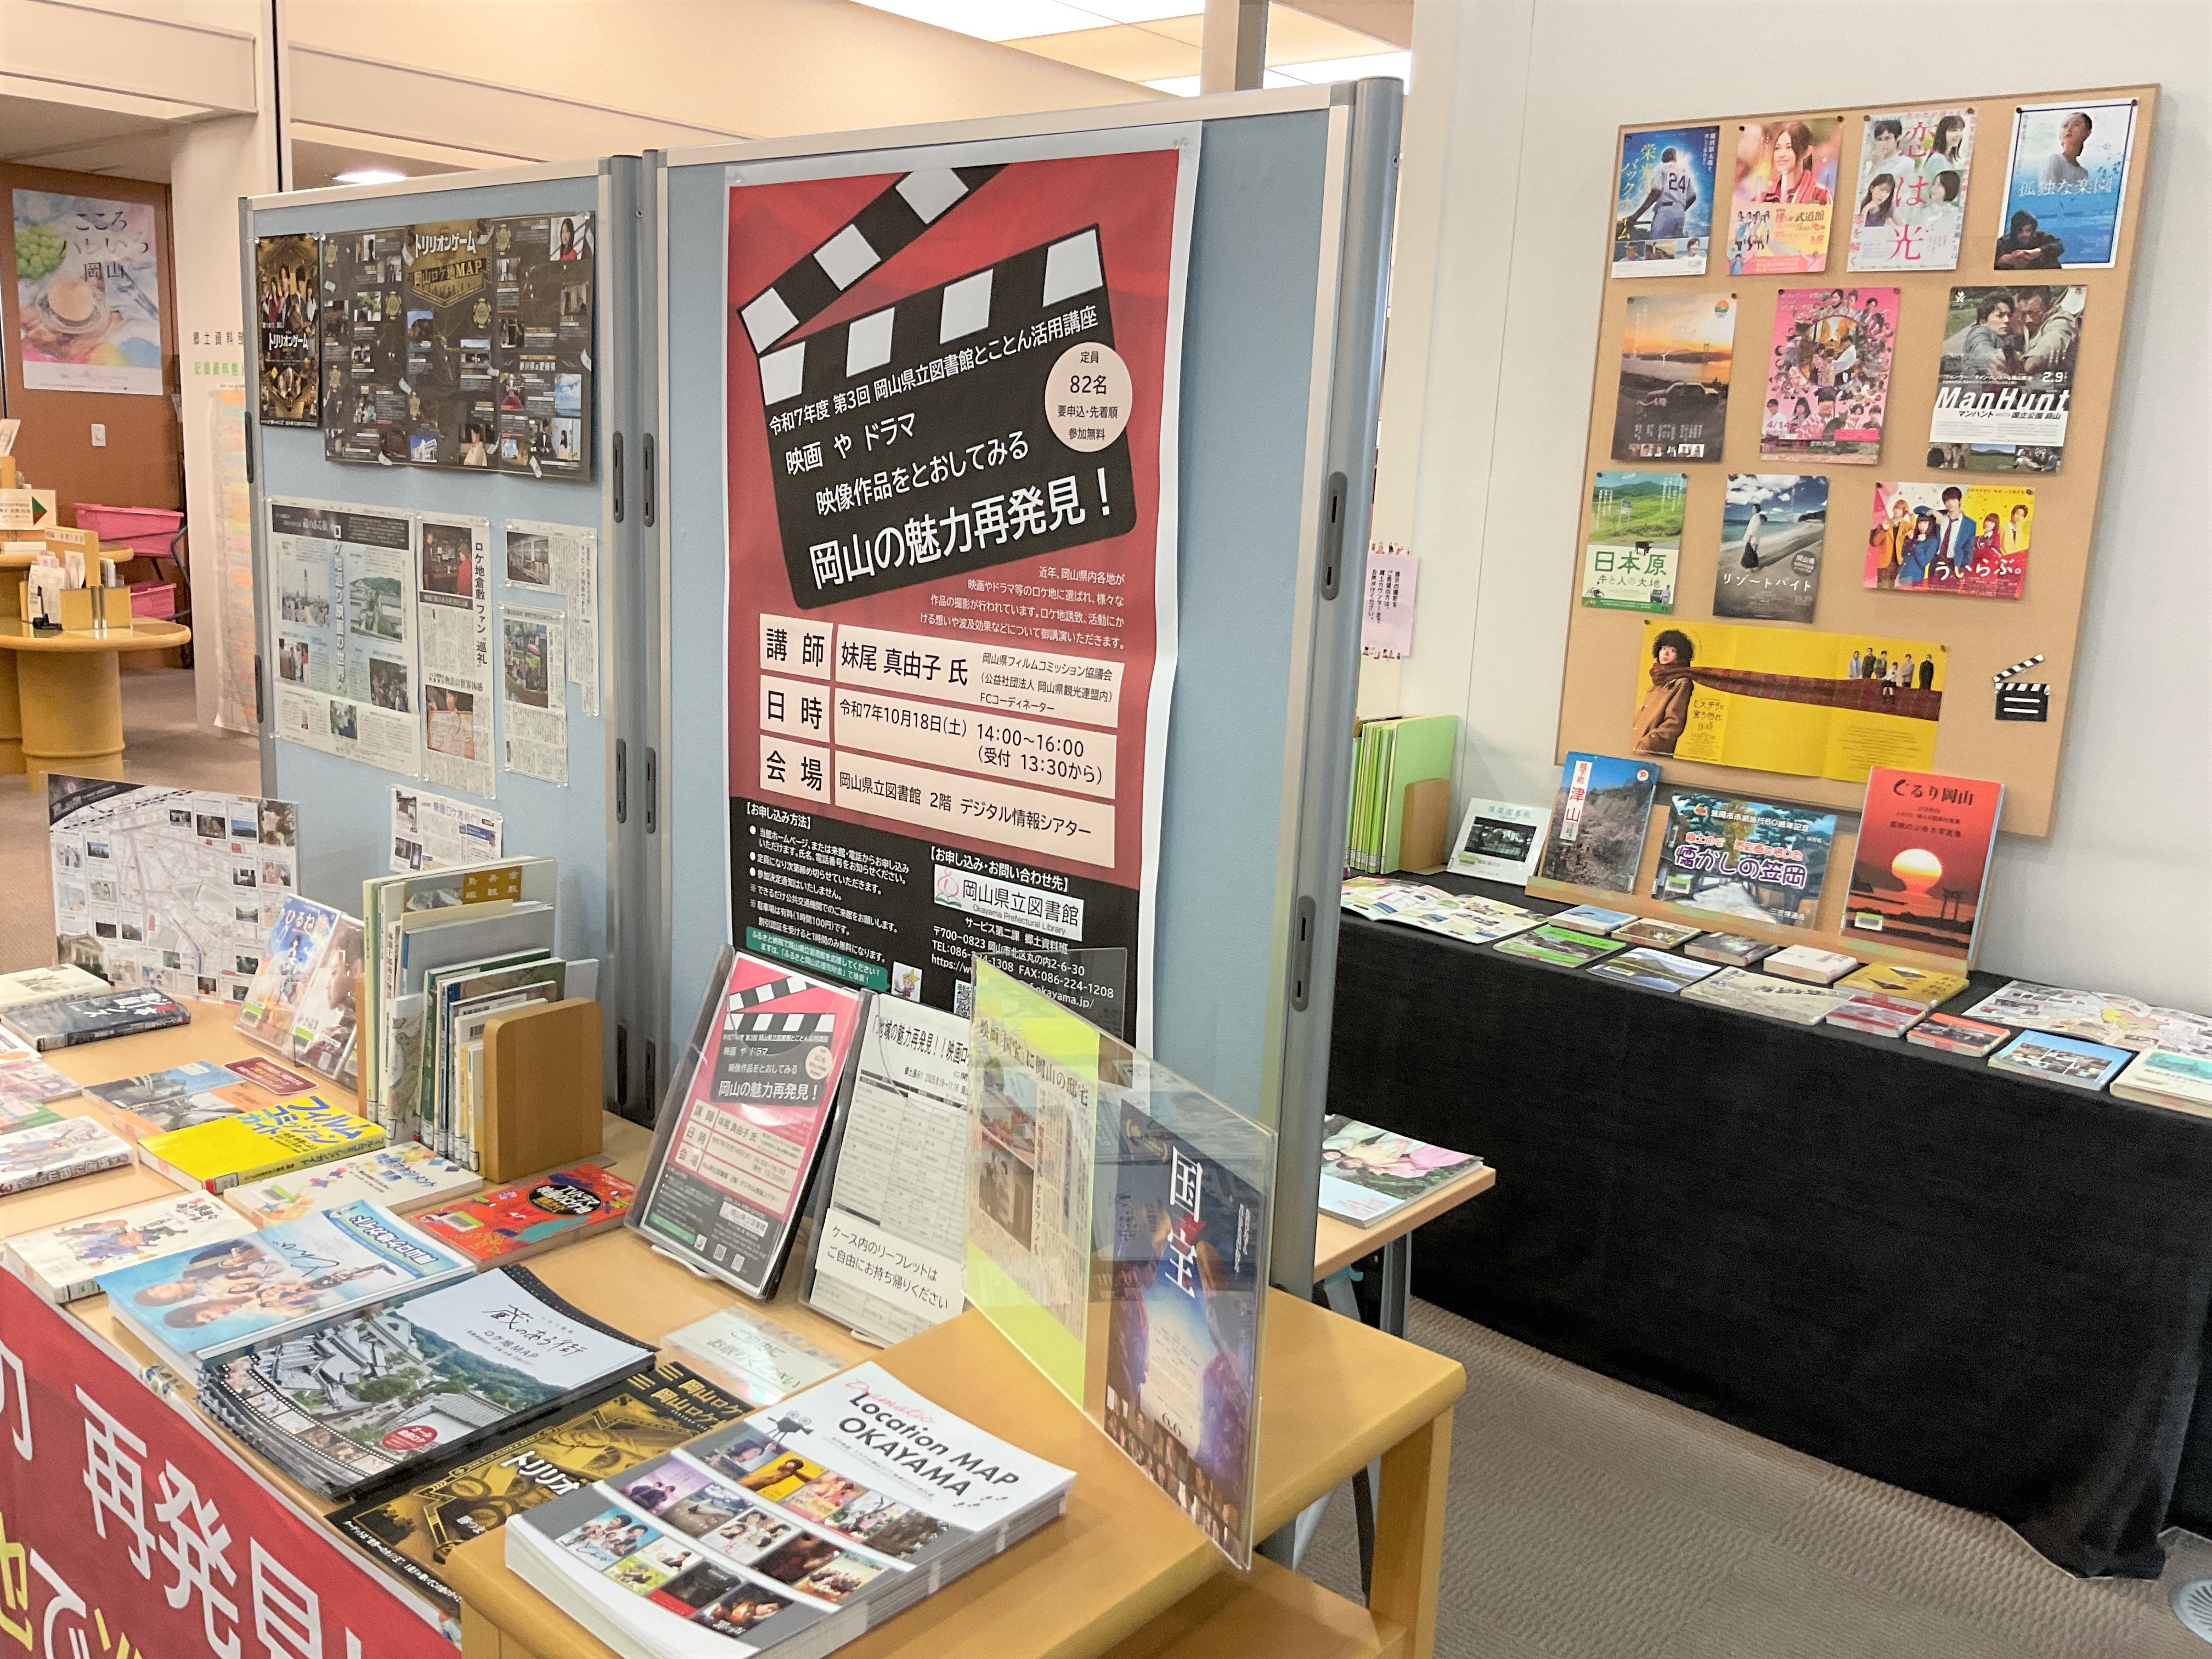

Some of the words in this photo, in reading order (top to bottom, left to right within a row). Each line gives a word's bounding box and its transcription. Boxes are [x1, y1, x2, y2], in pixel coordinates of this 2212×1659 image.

[1668, 172, 1686, 193] 24
[1887, 121, 1938, 260] 恋は光
[2018, 176, 2112, 198] 孤独な楽園
[76, 211, 127, 230] こころ
[415, 230, 477, 258] トリリオンゲーム
[84, 261, 124, 282] 岡山
[269, 331, 309, 352] トリリオンゲーム
[1080, 351, 1099, 364] 定員
[769, 398, 831, 437] 令和7年度
[833, 385, 871, 414] 第3回
[874, 305, 1098, 402] 岡山県立図書館とことん活用講座
[1069, 374, 1108, 396] 82名
[2042, 371, 2063, 383] 2.9
[1057, 404, 1118, 420] 要申込・先着順
[1938, 386, 2070, 411] ManHunt
[786, 439, 824, 476] 映画
[833, 433, 853, 461] や
[863, 411, 916, 453] ドラマ
[1068, 427, 1105, 441] 参加無料
[816, 430, 1030, 515] 映像作品をとおしてみる
[809, 467, 1110, 590] 岡山の魅力再発見！
[474, 542, 486, 601] ロケ地倉敷
[1039, 566, 1125, 585] 近年、岡山県内各地が
[1594, 551, 1667, 576] 日本原
[968, 579, 1124, 606] 映画やドラマ等のロケ地に選ばれ、様々な
[1598, 575, 1661, 588] 牛と人の大地
[1723, 573, 1812, 591] リゾートバイト
[930, 594, 1125, 628] 作品の撮影が行われています。ロケ地誘致、活動にか
[920, 612, 1124, 650] ける想いや波及効果などについて御講演いただきます。
[841, 641, 878, 673] 妹尾
[883, 647, 941, 682] 真由子
[949, 659, 968, 687] 氏
[983, 652, 1113, 681] 岡山県フィルムコミッション協議会
[839, 698, 967, 738] 令和7年10月18日（土）
[980, 693, 1055, 712] FCコーディネーター
[839, 771, 921, 806] 岡山県立図書館
[930, 791, 952, 812] 2階
[960, 800, 1092, 837] デジタル情報シアター
[1565, 786, 1587, 823] 津山
[1893, 778, 1974, 806] ぐるり岡山
[747, 802, 811, 830] 【お申し込み方法】
[930, 846, 1068, 892] 【お申し込み・お問い合わせ先】
[1674, 844, 1808, 889] 懐かしの笠岡
[963, 879, 1079, 927] 岡山県立図書館
[973, 904, 1002, 919] Okayama
[1004, 911, 1040, 928] Prefectural
[1042, 922, 1066, 935] Library
[966, 917, 1020, 942] サービス第二課
[933, 926, 985, 949] 〒700-0823
[988, 940, 1085, 976] 岡山市北区丸の内2-6-30
[1019, 964, 1114, 998] FAX:086-224-1208
[718, 1080, 817, 1101] 岡山の魅力再発見！
[236, 1113, 276, 1135] ガイド
[261, 1104, 348, 1144] コミッション
[287, 1095, 373, 1139] フィルム
[1165, 1144, 1203, 1299] 国宝
[833, 1226, 937, 1282] ケース内のリーフレットは
[828, 1246, 948, 1309] ご自由にお持ち帰りください
[482, 1304, 589, 1358] 蔵のある街
[651, 1387, 726, 1424] 岡山ロケ
[849, 1392, 949, 1456] Location
[949, 1452, 1019, 1487] MAP
[500, 1449, 582, 1496] トリリオ
[838, 1417, 972, 1497] OKAYAMA
